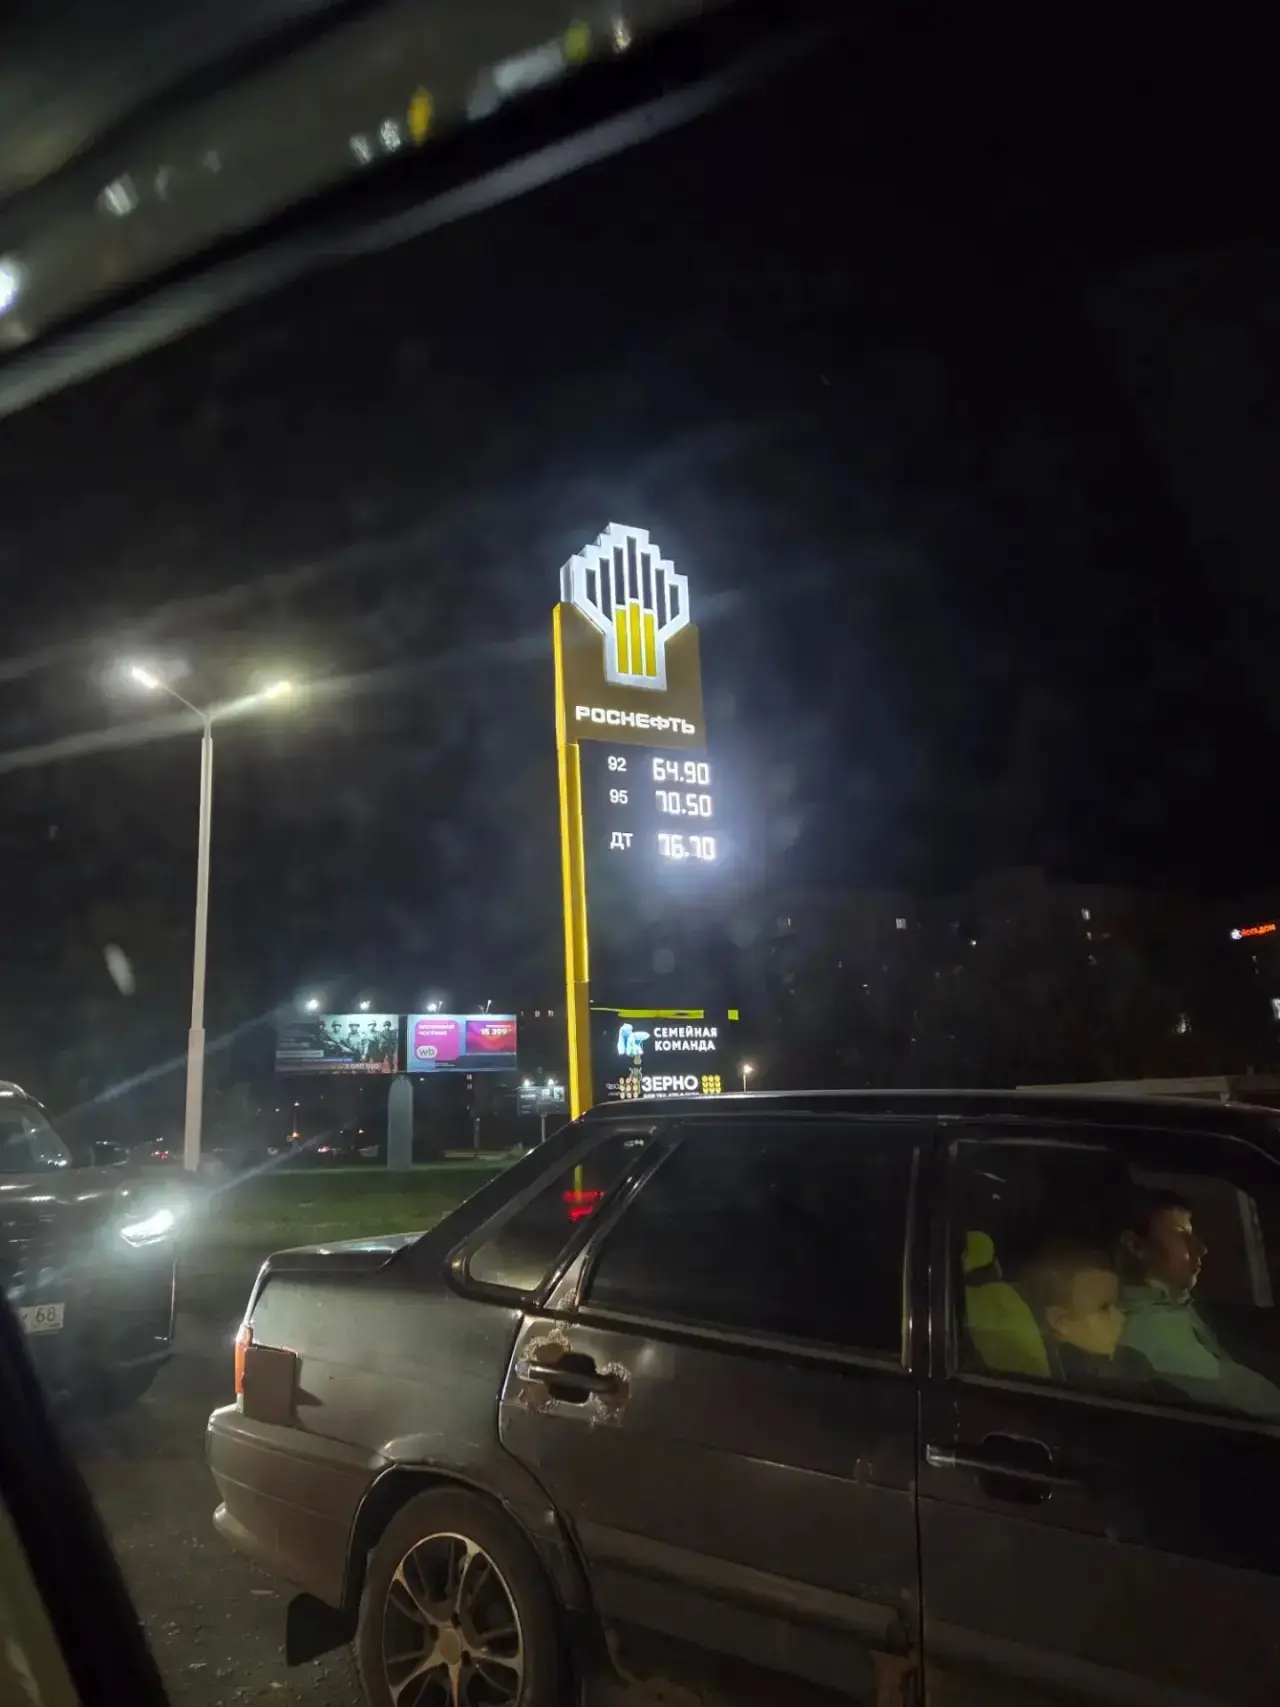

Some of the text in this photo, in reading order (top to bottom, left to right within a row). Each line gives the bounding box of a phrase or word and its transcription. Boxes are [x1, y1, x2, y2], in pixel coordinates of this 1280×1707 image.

[575, 705, 695, 734] РОСНЕФТЬ
[608, 756, 710, 785] 92 64.90
[609, 789, 712, 817] 95 70.50
[610, 831, 717, 860] ДТ 76.70
[653, 1025, 718, 1038] СЕМЕЙНАЯ
[654, 1040, 716, 1052] КОМАНДА
[641, 1074, 699, 1092] ЗЕРНО
[36, 1306, 57, 1323] 68
